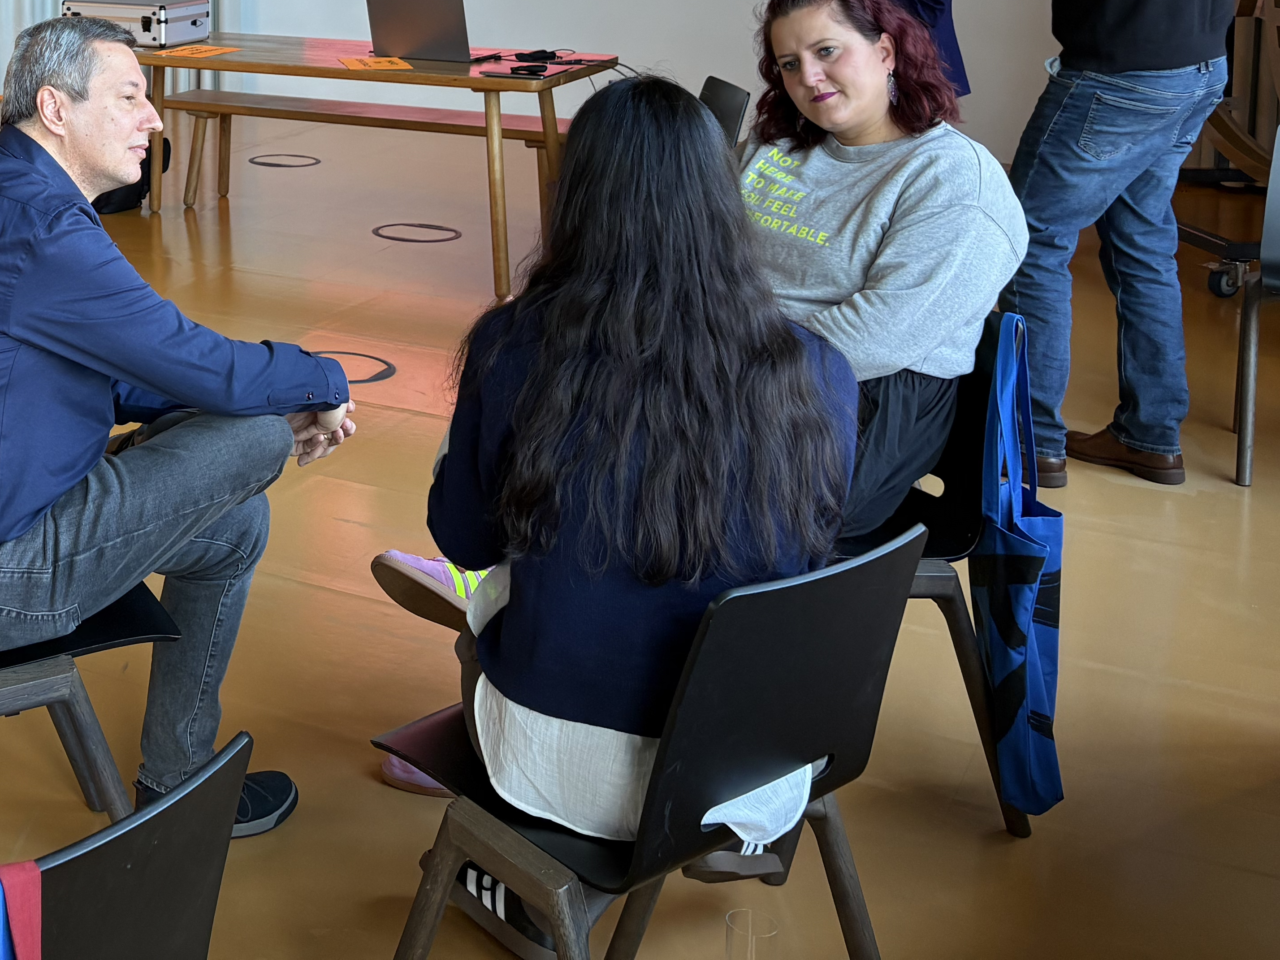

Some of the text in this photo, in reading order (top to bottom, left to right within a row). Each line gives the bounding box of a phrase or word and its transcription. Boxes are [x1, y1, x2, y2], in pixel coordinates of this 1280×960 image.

[768, 148, 801, 168] NOT
[755, 159, 796, 183] HERE
[745, 171, 807, 202] TO MAKE
[763, 198, 797, 218] FEEL
[747, 209, 830, 247] FORTABLE.
